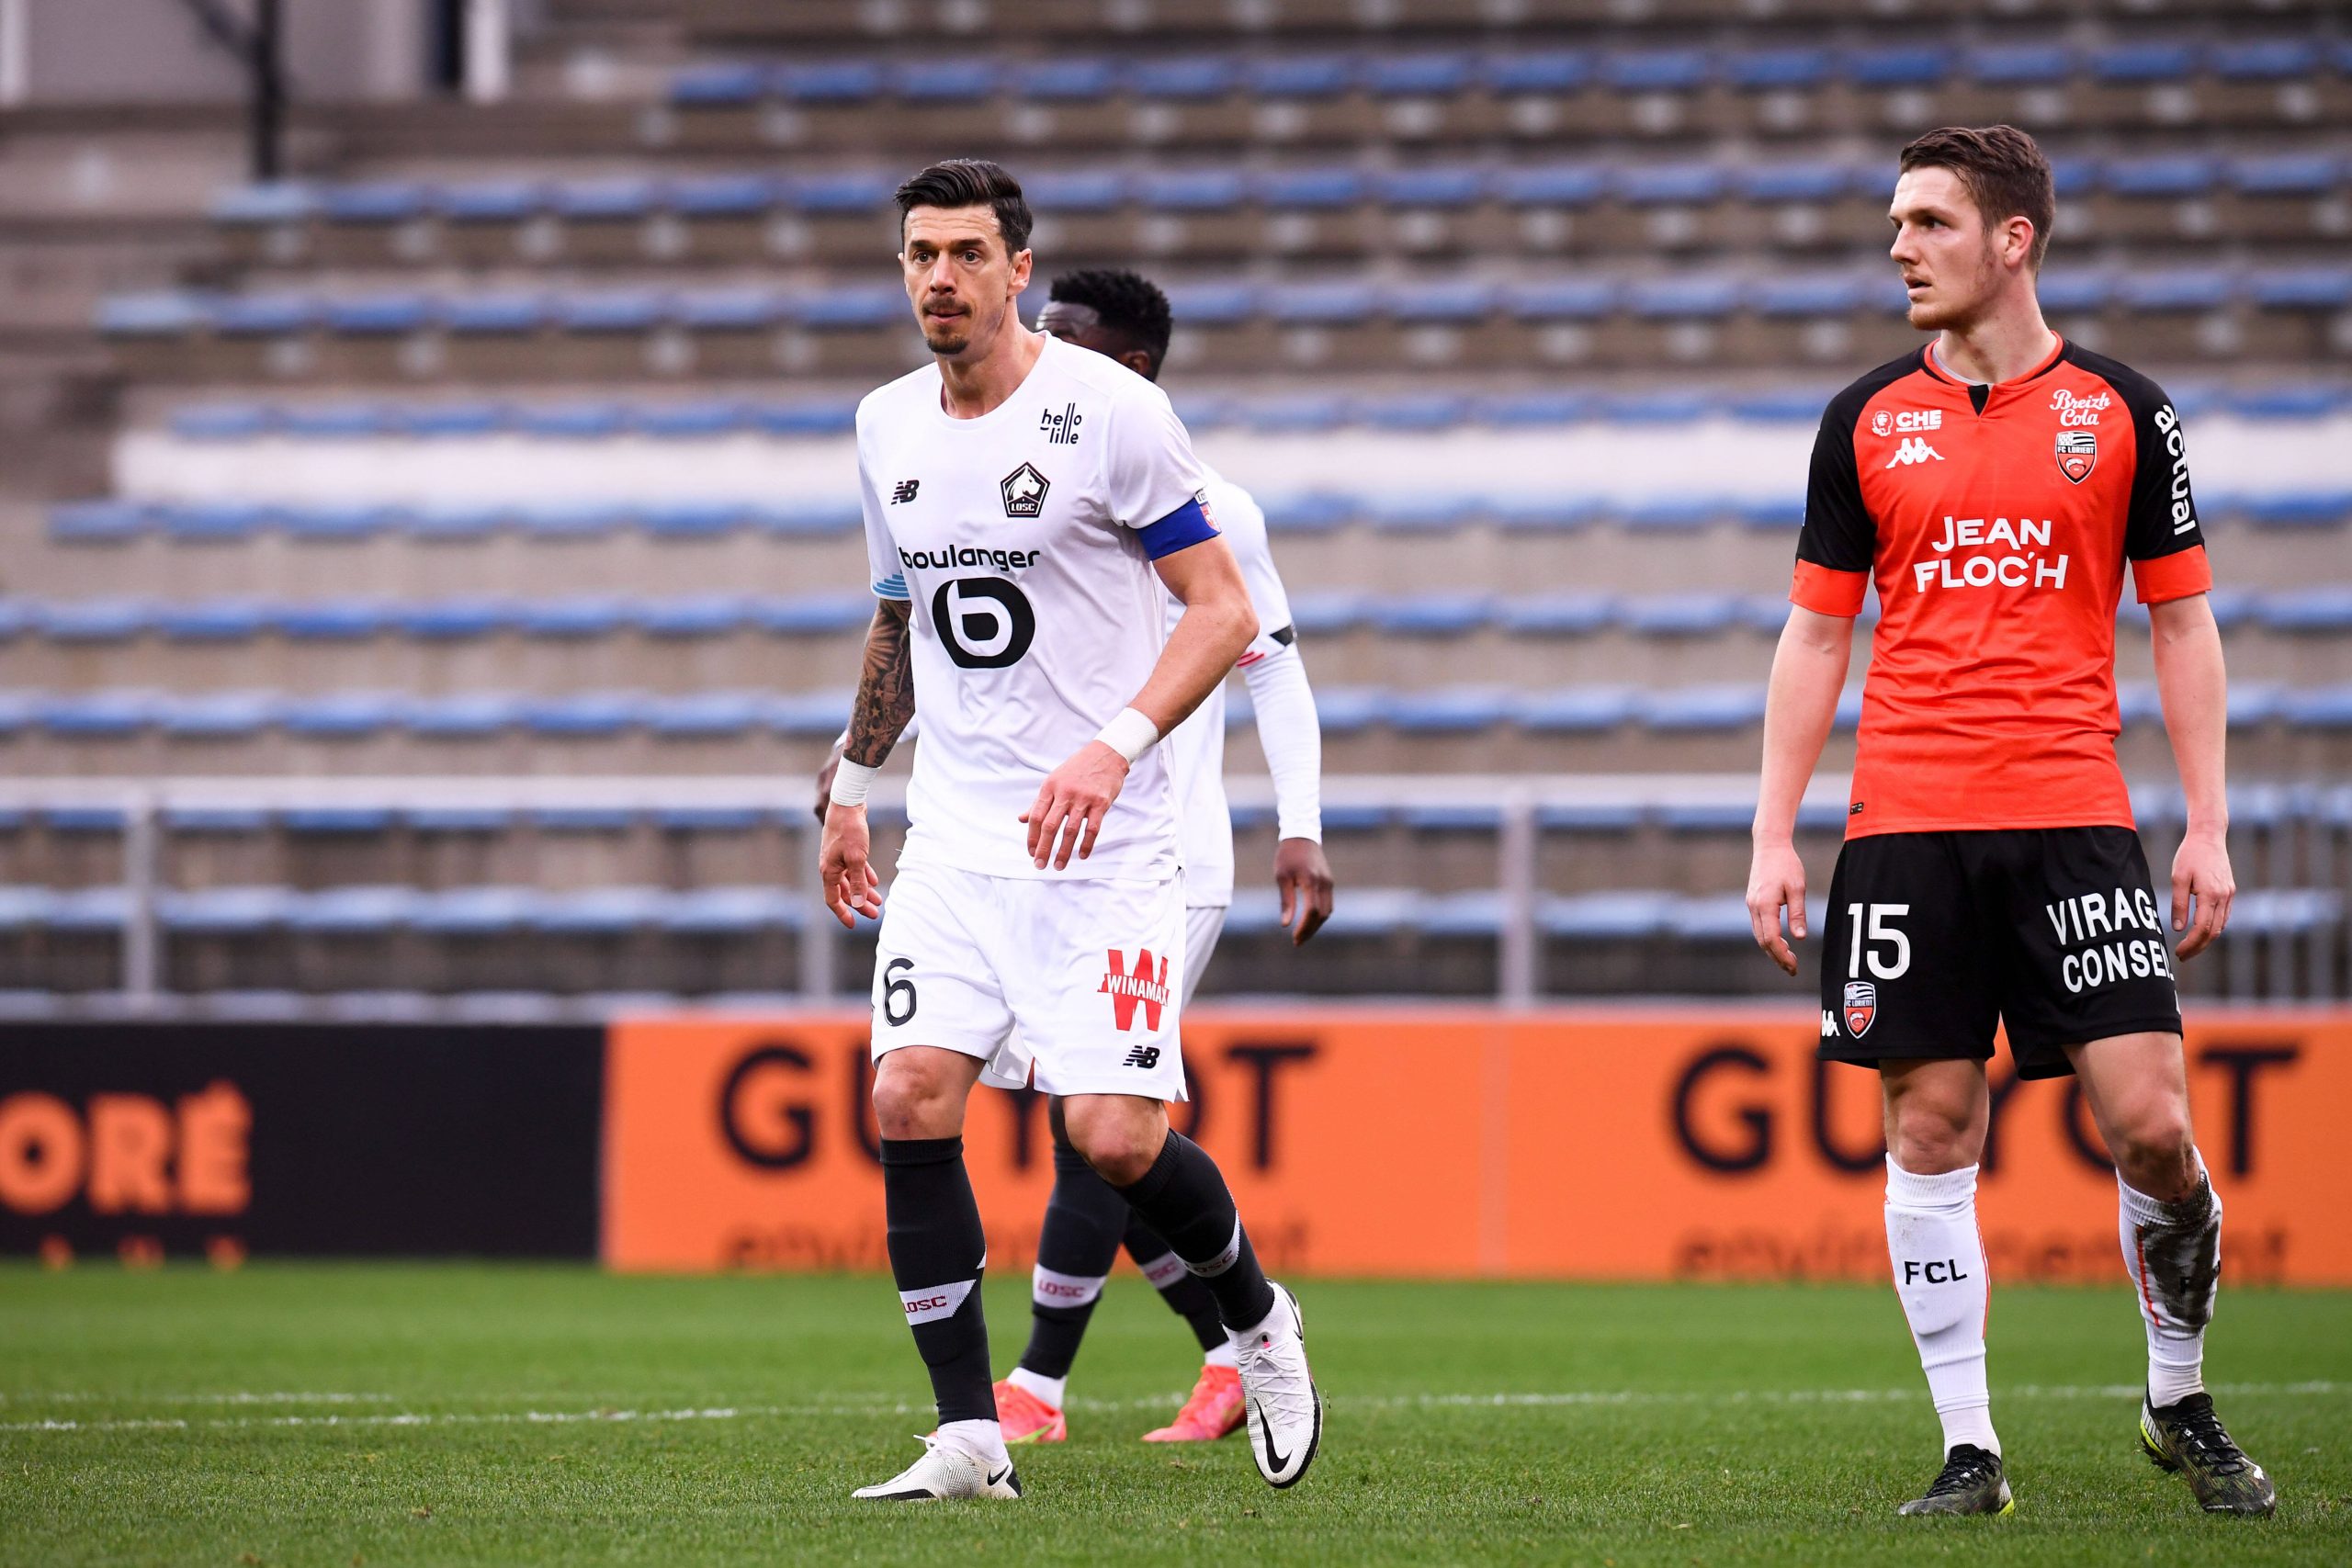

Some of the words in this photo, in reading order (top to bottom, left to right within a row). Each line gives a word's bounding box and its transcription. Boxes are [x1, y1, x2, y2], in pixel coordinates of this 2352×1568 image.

[2049, 389, 2111, 411] Breizh
[1041, 402, 1082, 426] hello
[1895, 410, 1941, 427] CHE
[2060, 409, 2100, 427] Cola
[1049, 427, 1080, 445] lille
[2058, 446, 2067, 454] FC
[2068, 446, 2095, 455] LORIENT
[2154, 404, 2196, 536] actual
[1011, 502, 1035, 512] LOSC
[1931, 515, 2052, 552] JEAN
[899, 544, 1041, 572] boulanger
[1913, 551, 2069, 593] FLOC'H
[1848, 902, 1911, 980] 15
[883, 957, 915, 1027] 6
[1106, 974, 1169, 1008] WINAMAX
[718, 1043, 1317, 1171] GYT
[1904, 1258, 1968, 1285] FCL
[1039, 1280, 1086, 1298] LOSC
